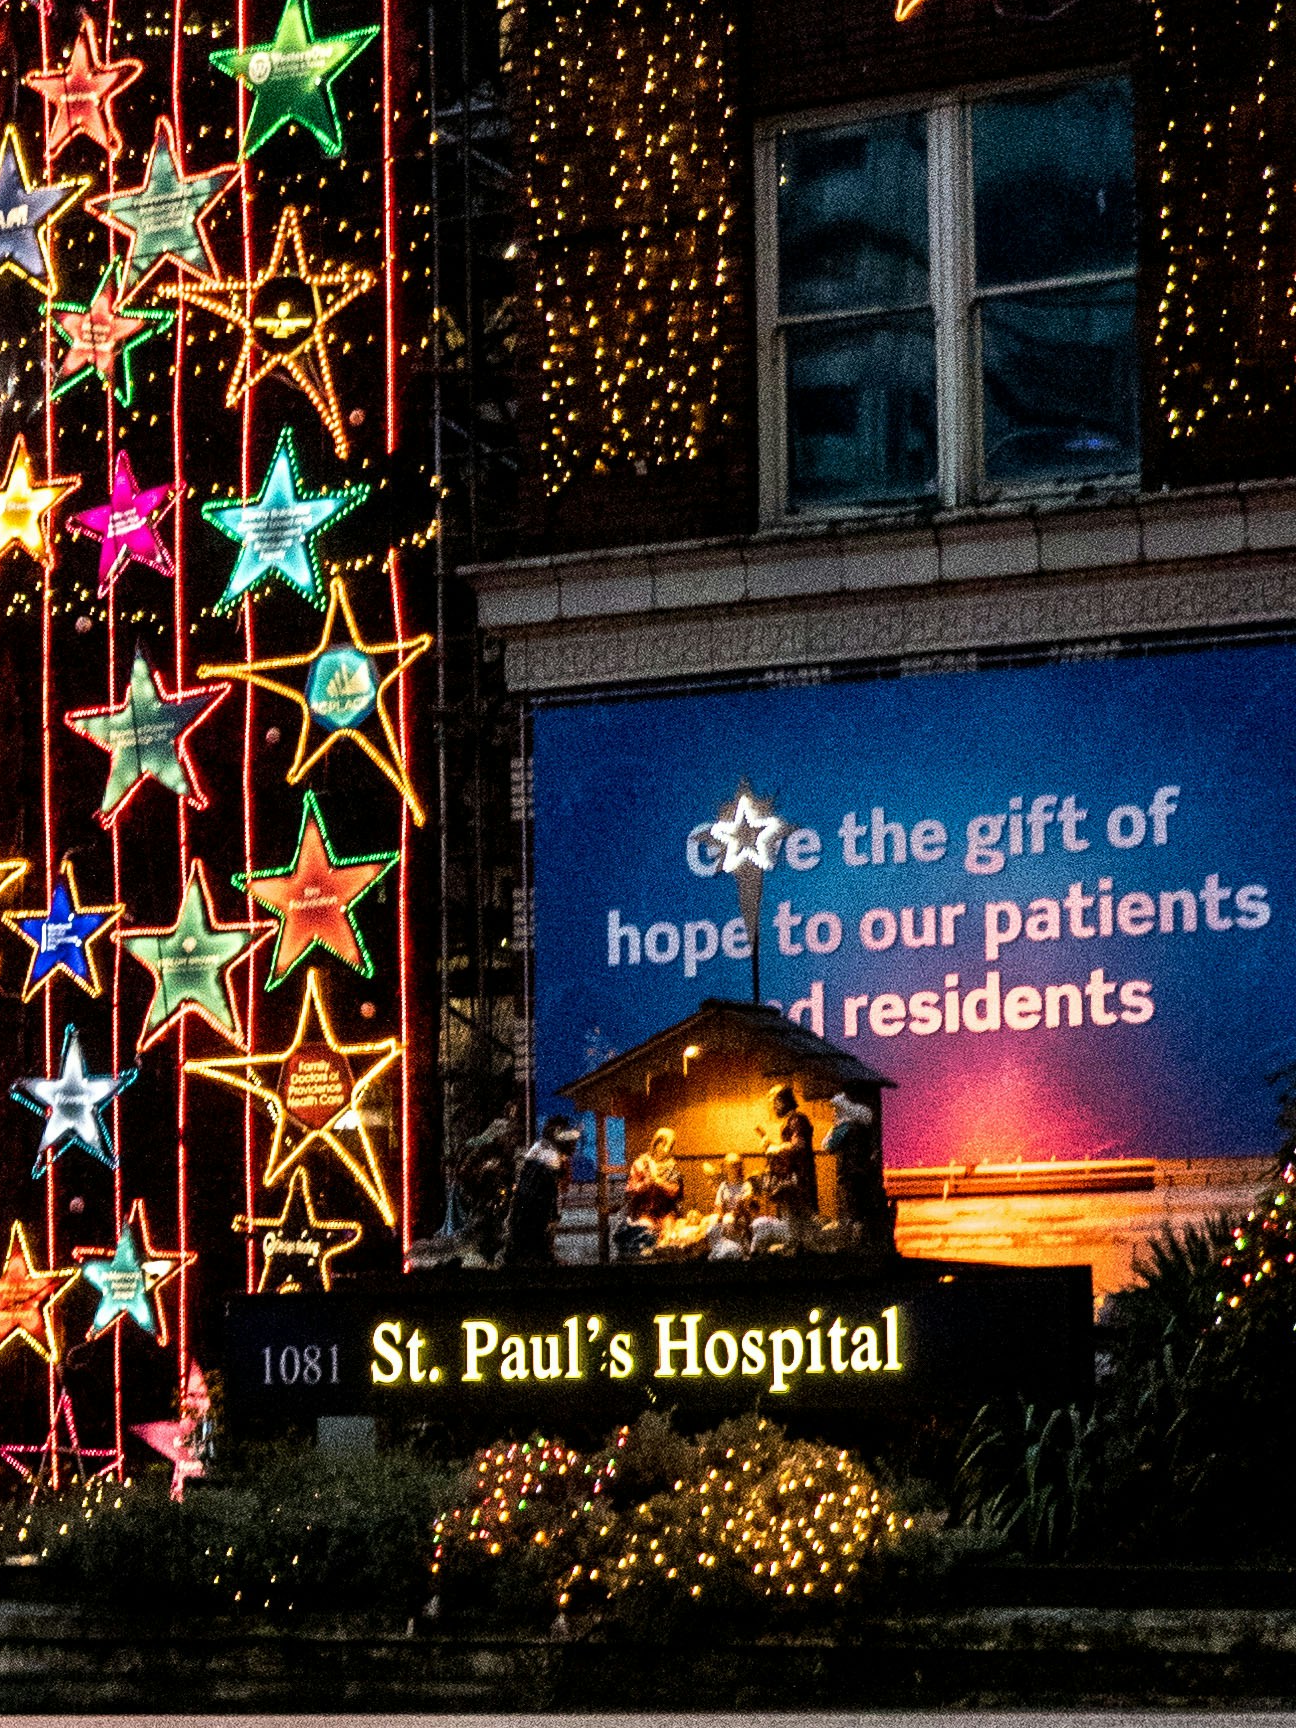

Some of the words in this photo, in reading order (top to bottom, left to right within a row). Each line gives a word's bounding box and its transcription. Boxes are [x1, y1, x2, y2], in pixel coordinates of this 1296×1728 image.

[686, 819, 822, 877] Ge
[838, 806, 947, 867] the
[964, 794, 1091, 875] gift
[1106, 784, 1181, 850] of
[607, 908, 755, 977] hope
[773, 899, 843, 956] to
[859, 902, 966, 952] our
[984, 873, 1272, 962] patients
[844, 968, 1155, 1039] residents
[260, 1344, 342, 1386] 1081
[371, 1321, 440, 1384] St.
[461, 1315, 635, 1382] Paul's
[654, 1305, 904, 1394] Hospital
